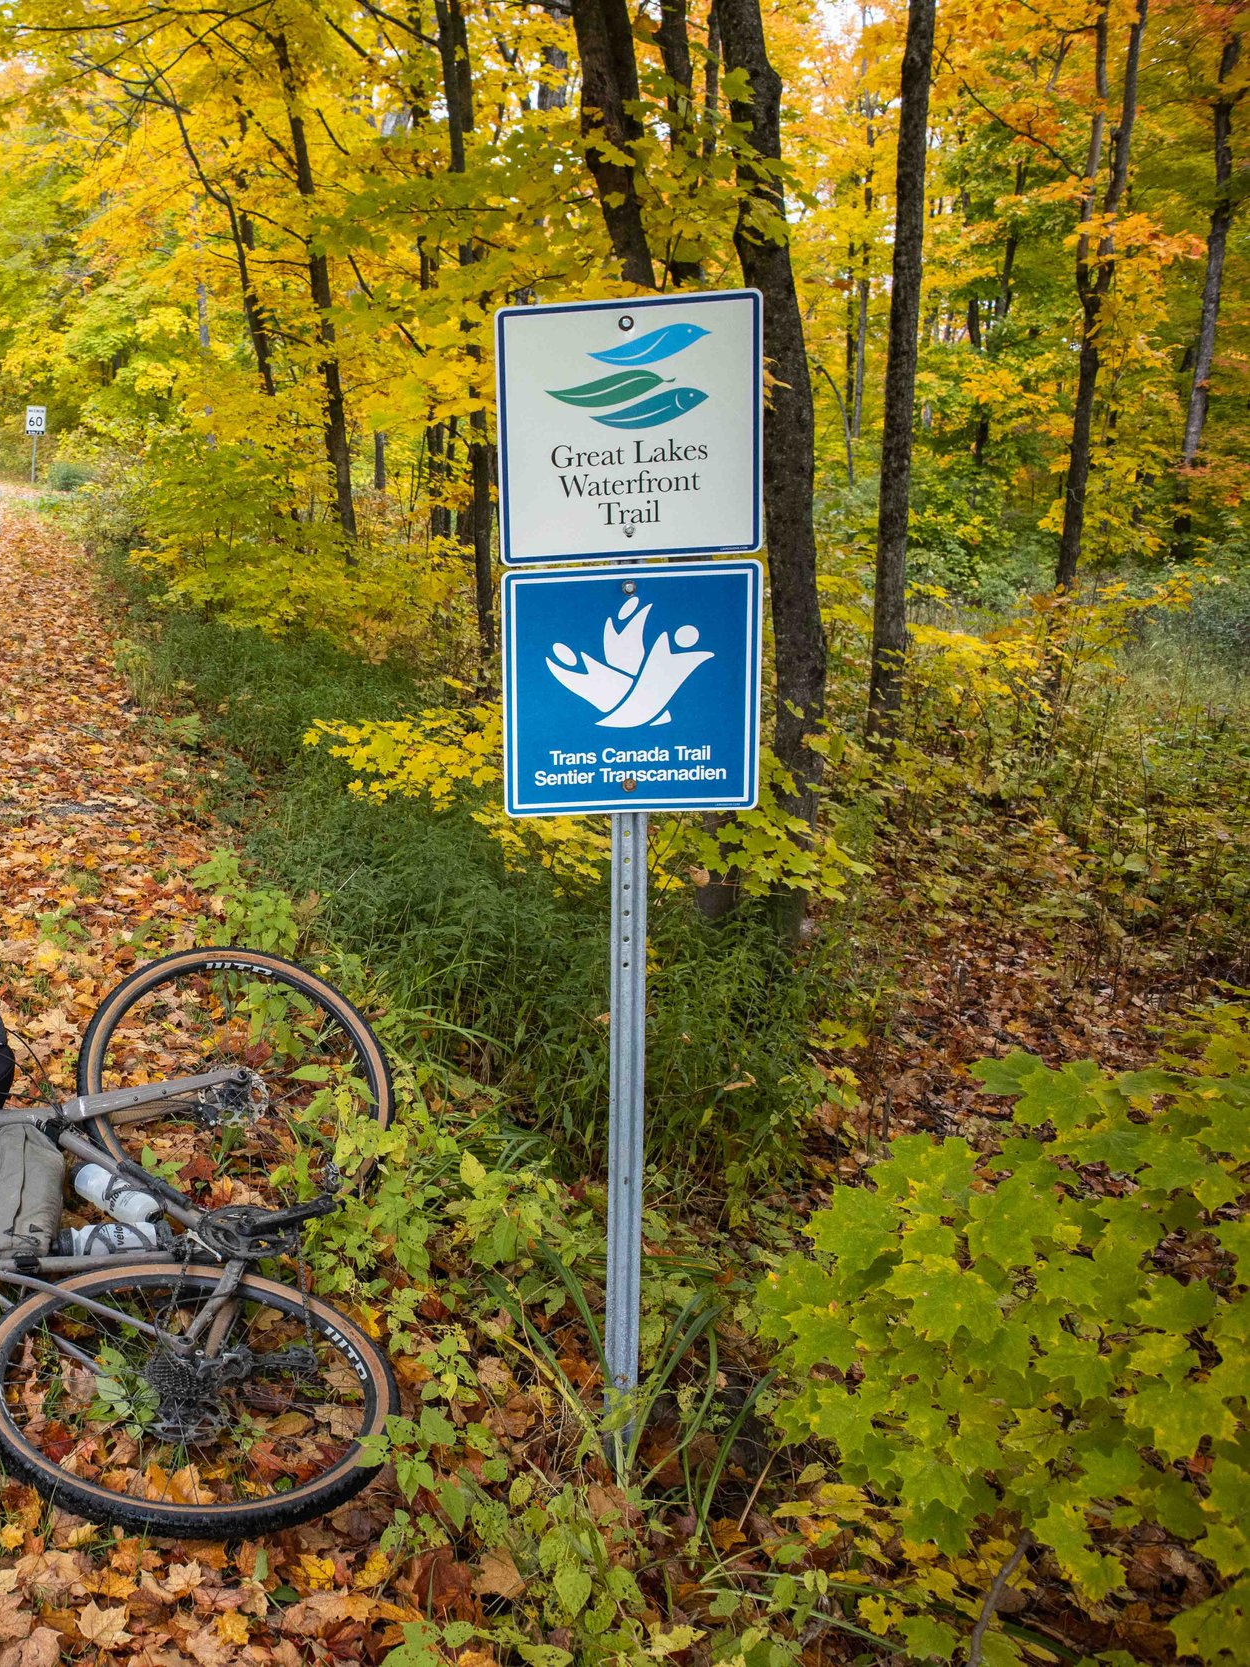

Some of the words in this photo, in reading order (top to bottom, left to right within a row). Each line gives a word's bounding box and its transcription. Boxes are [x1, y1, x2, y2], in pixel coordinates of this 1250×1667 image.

[28, 416, 43, 427] 60
[551, 444, 624, 468] Great
[633, 439, 708, 464] Lakes
[558, 470, 701, 498] Waterfront
[598, 500, 661, 526] Trail
[550, 750, 597, 766] Trans
[602, 746, 669, 764] Canada
[674, 745, 711, 761] Trail
[534, 769, 595, 786] Sentier
[599, 765, 727, 784] Transcanadien
